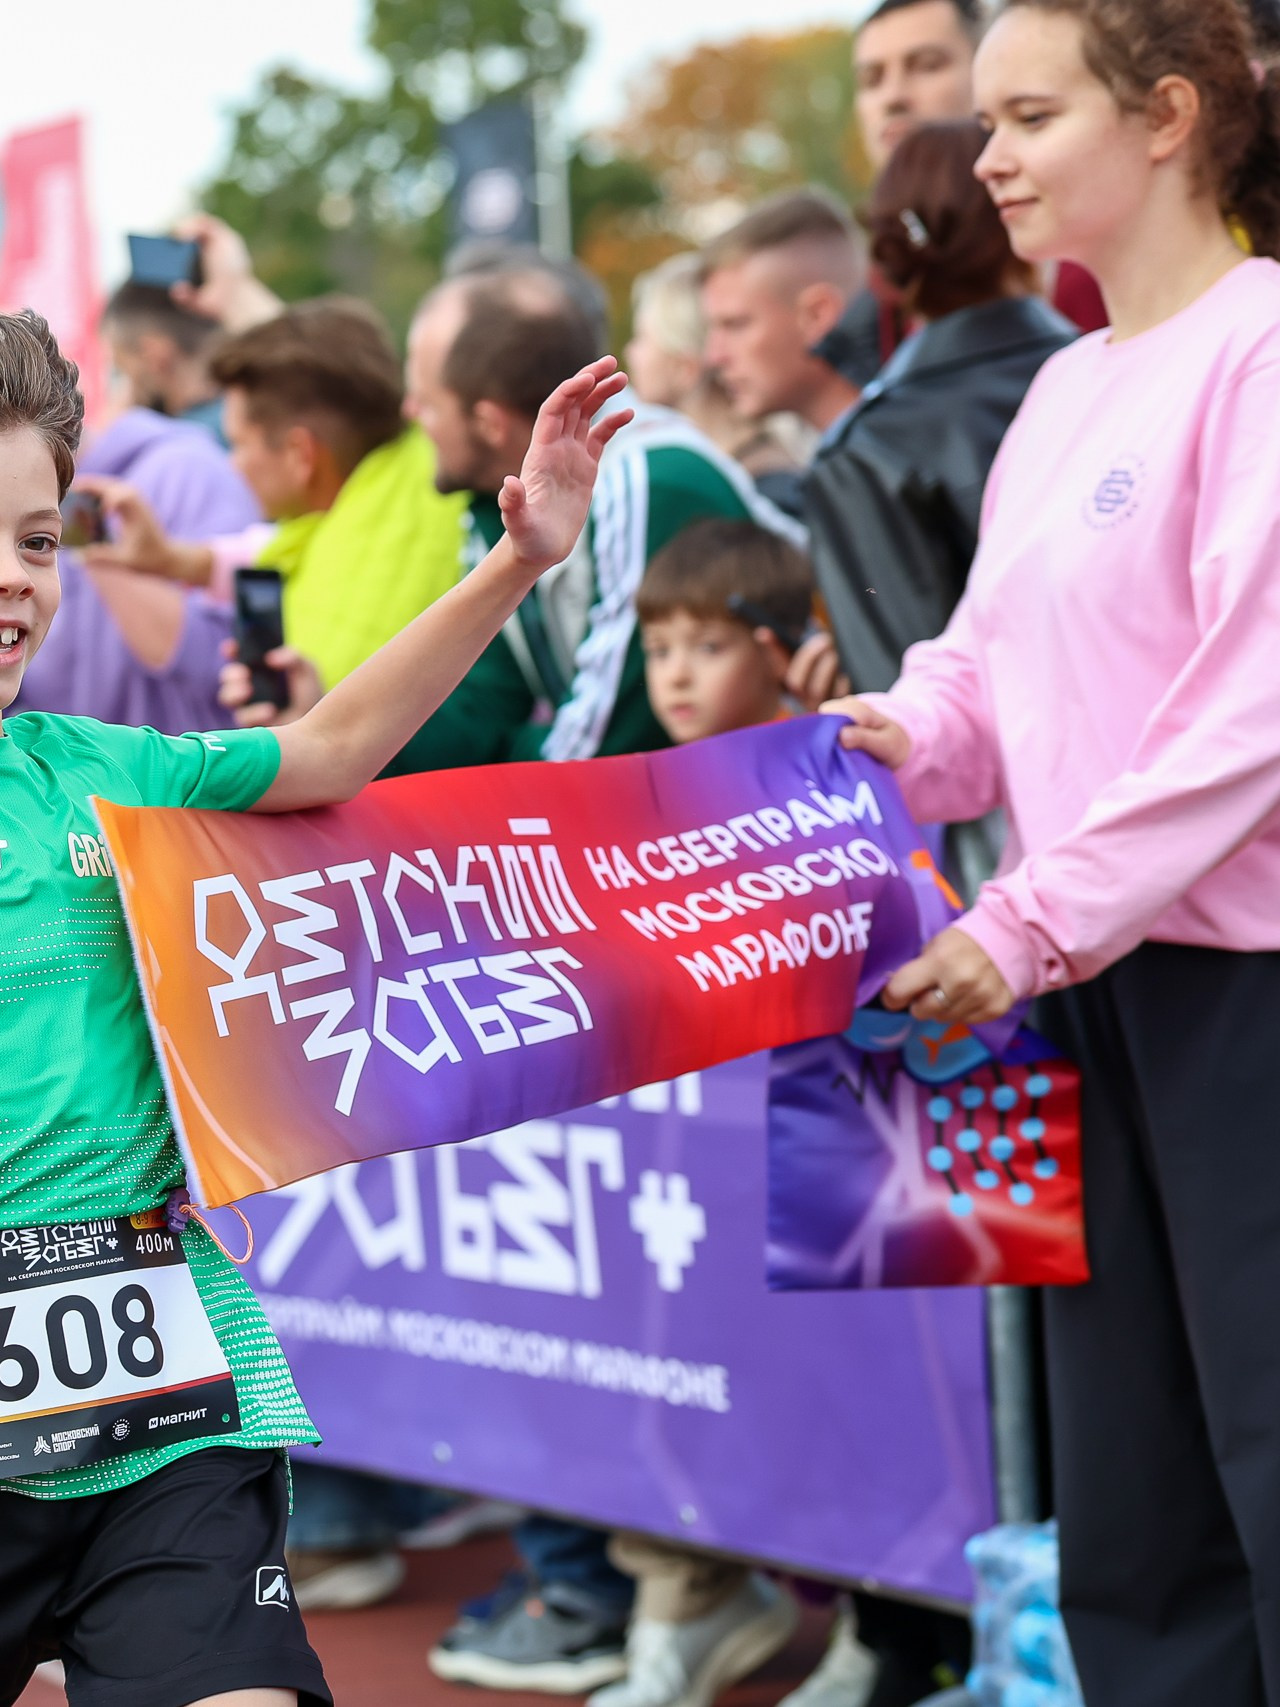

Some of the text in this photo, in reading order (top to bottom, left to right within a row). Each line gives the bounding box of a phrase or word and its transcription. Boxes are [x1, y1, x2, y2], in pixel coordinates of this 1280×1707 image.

[585, 778, 884, 891] НА СБЕРПРАЙМ
[620, 838, 899, 941] МОСКОВСКО
[193, 817, 597, 1038] ДЕТСКИЙ
[53, 1261, 95, 1273] МОСКОВСКОМ
[51, 1423, 100, 1444] МОСКОВСКИЙ
[52, 1439, 76, 1453] СПОРТ
